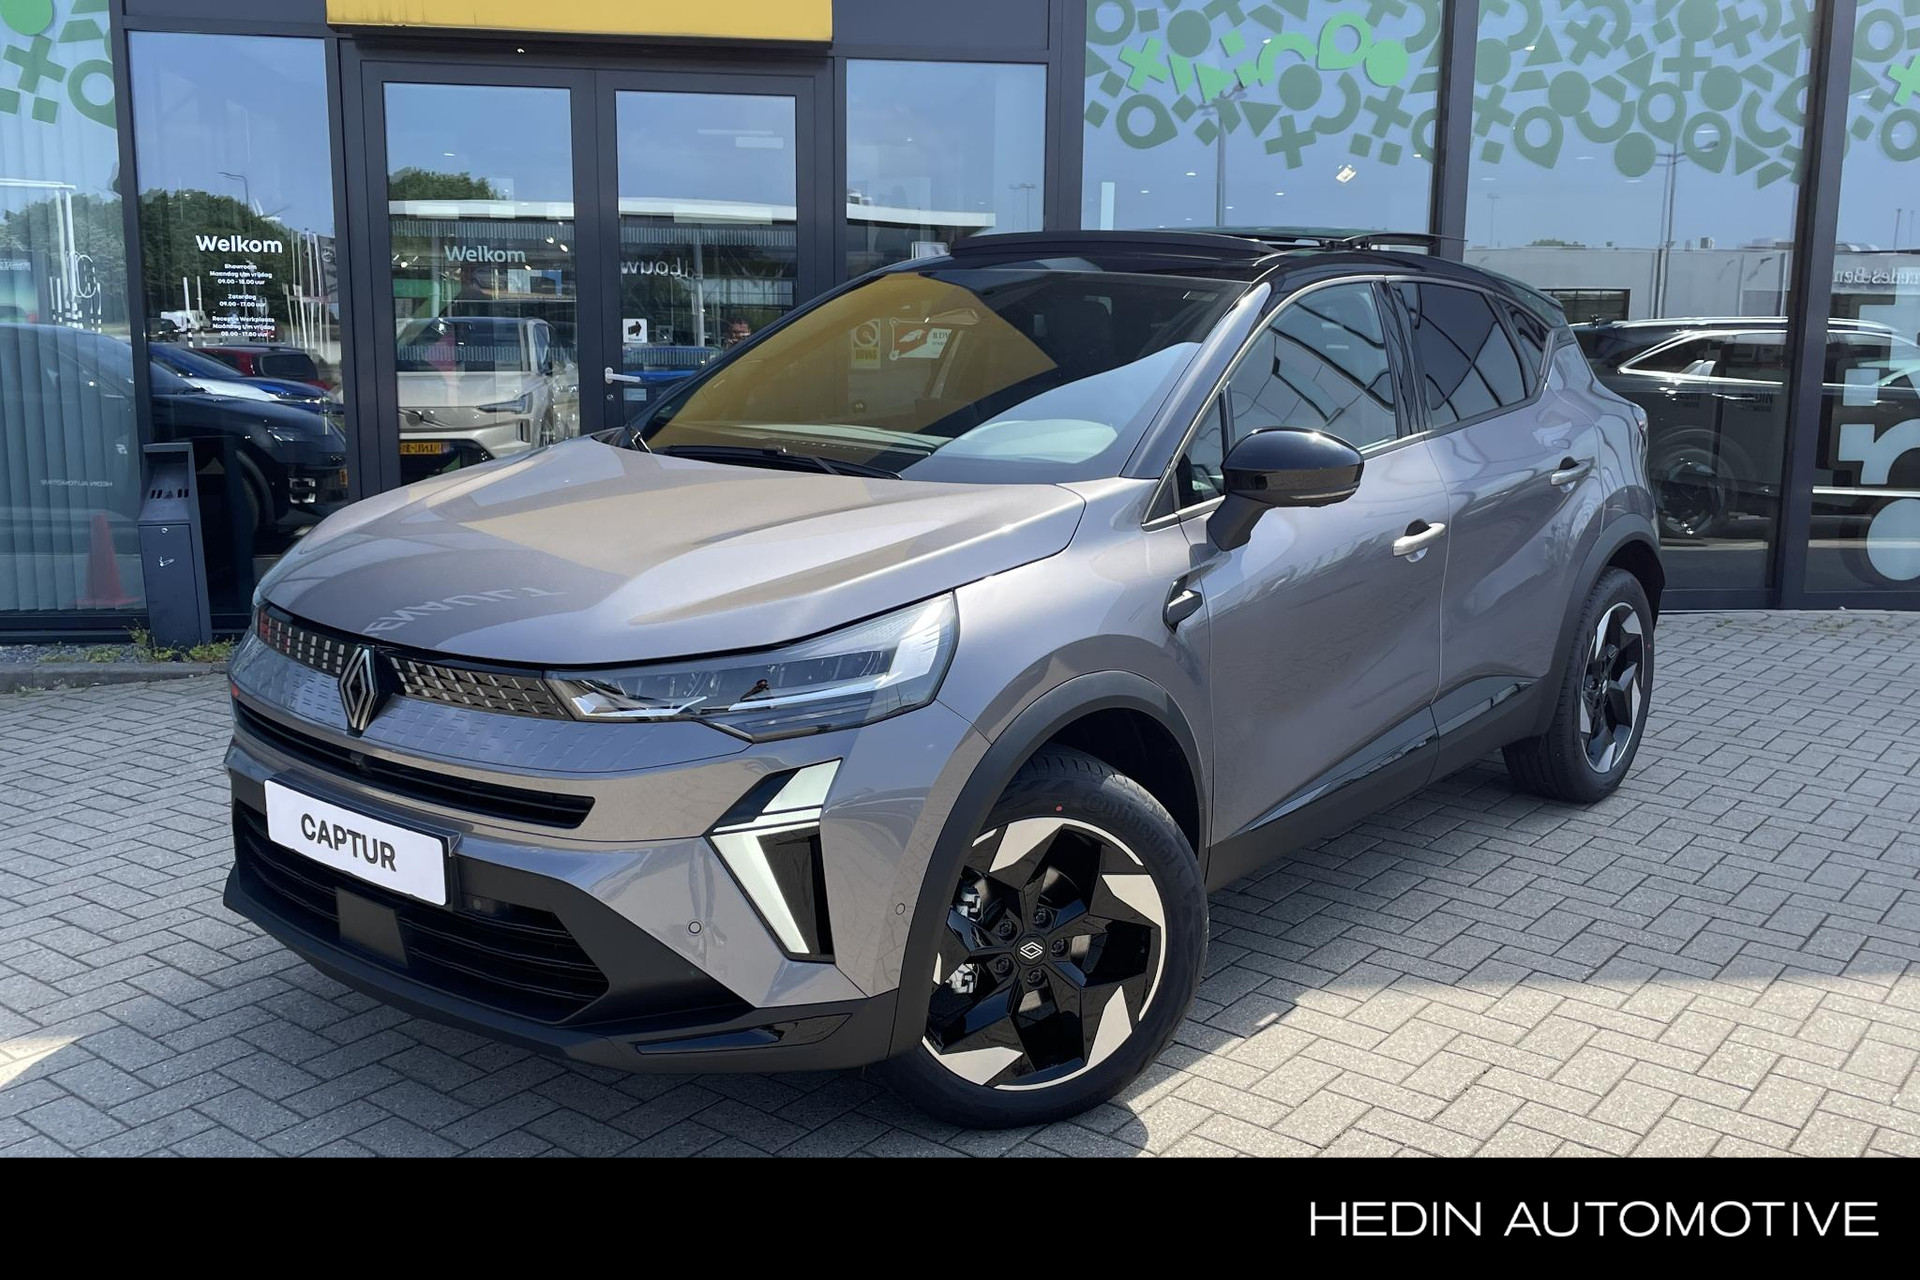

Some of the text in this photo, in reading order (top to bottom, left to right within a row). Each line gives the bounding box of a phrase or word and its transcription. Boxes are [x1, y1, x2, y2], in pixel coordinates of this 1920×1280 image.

[196, 235, 283, 253] Welkom
[444, 245, 526, 263] Welkom
[210, 270, 239, 278] Maandag
[301, 813, 397, 872] CAPTUR
